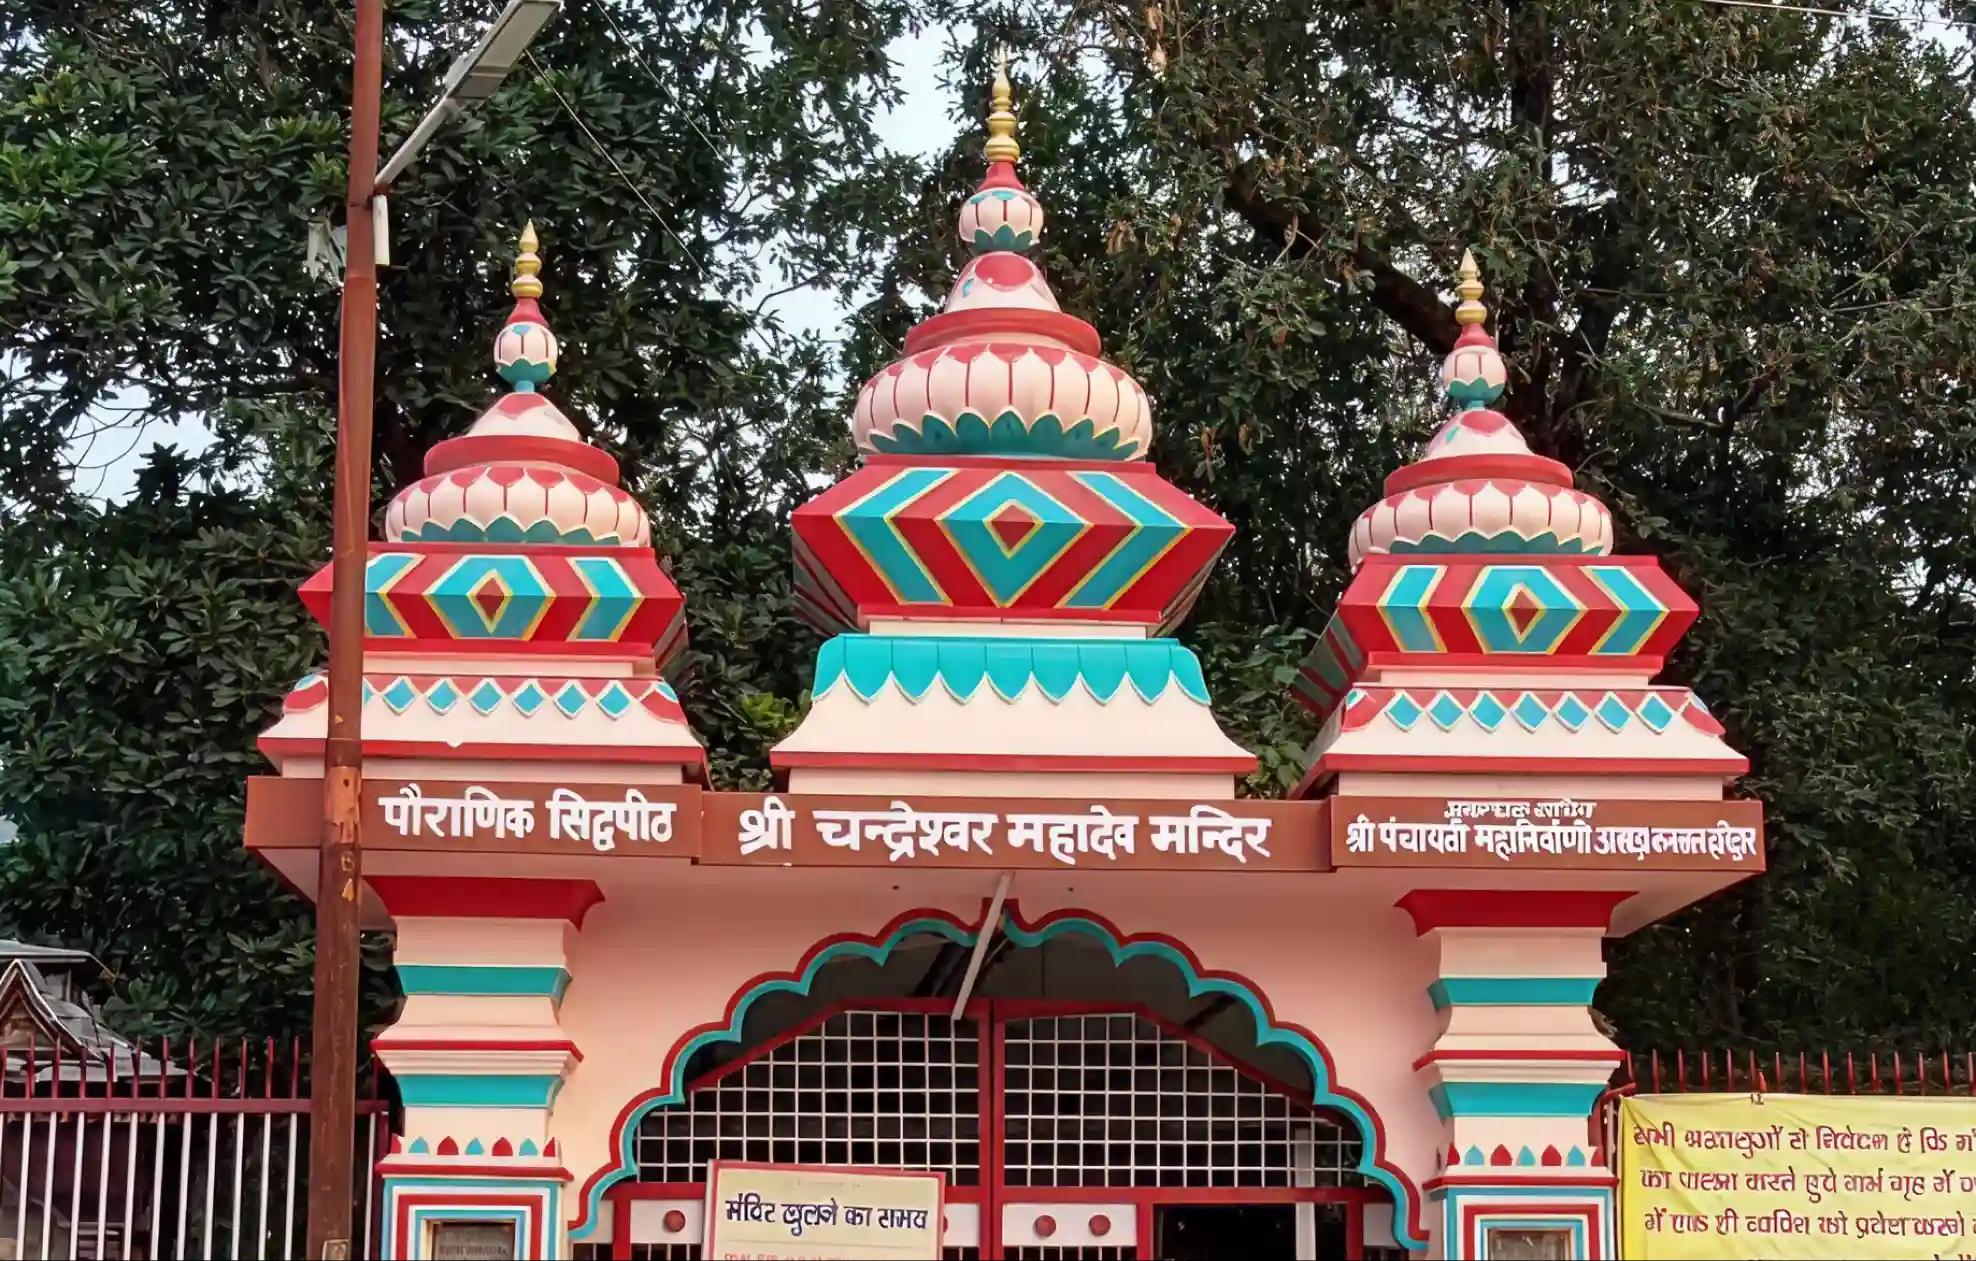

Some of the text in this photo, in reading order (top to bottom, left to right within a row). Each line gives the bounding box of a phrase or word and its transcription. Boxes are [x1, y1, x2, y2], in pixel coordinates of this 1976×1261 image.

[378, 783, 535, 838] पौराणिक
[739, 797, 1272, 865] श्री चन्द्रेश्वर महादेव मन्दिर
[1346, 813, 1376, 853] श्री
[843, 1206, 873, 1226] का
